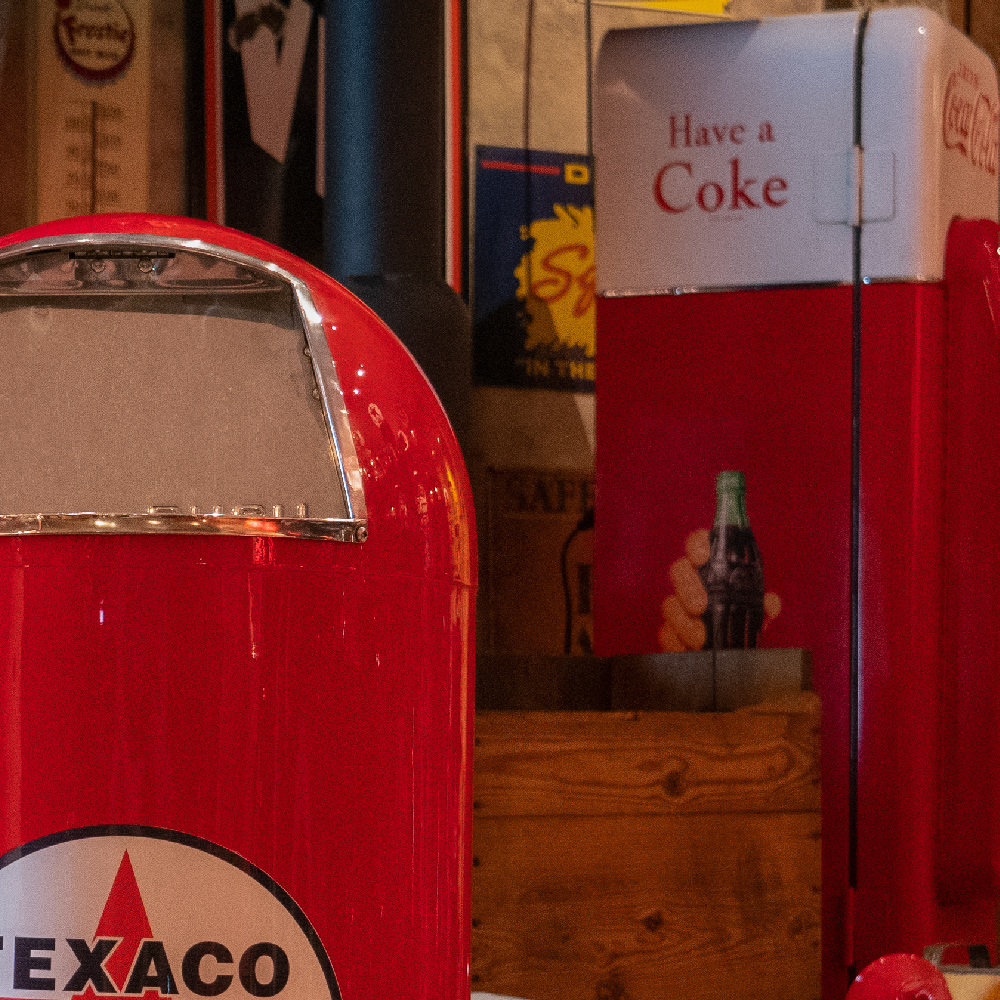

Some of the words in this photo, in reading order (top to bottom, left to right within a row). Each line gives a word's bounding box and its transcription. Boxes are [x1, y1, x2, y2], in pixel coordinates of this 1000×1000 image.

[669, 113, 745, 149] Have
[757, 120, 775, 143] a
[653, 155, 789, 215] Coke
